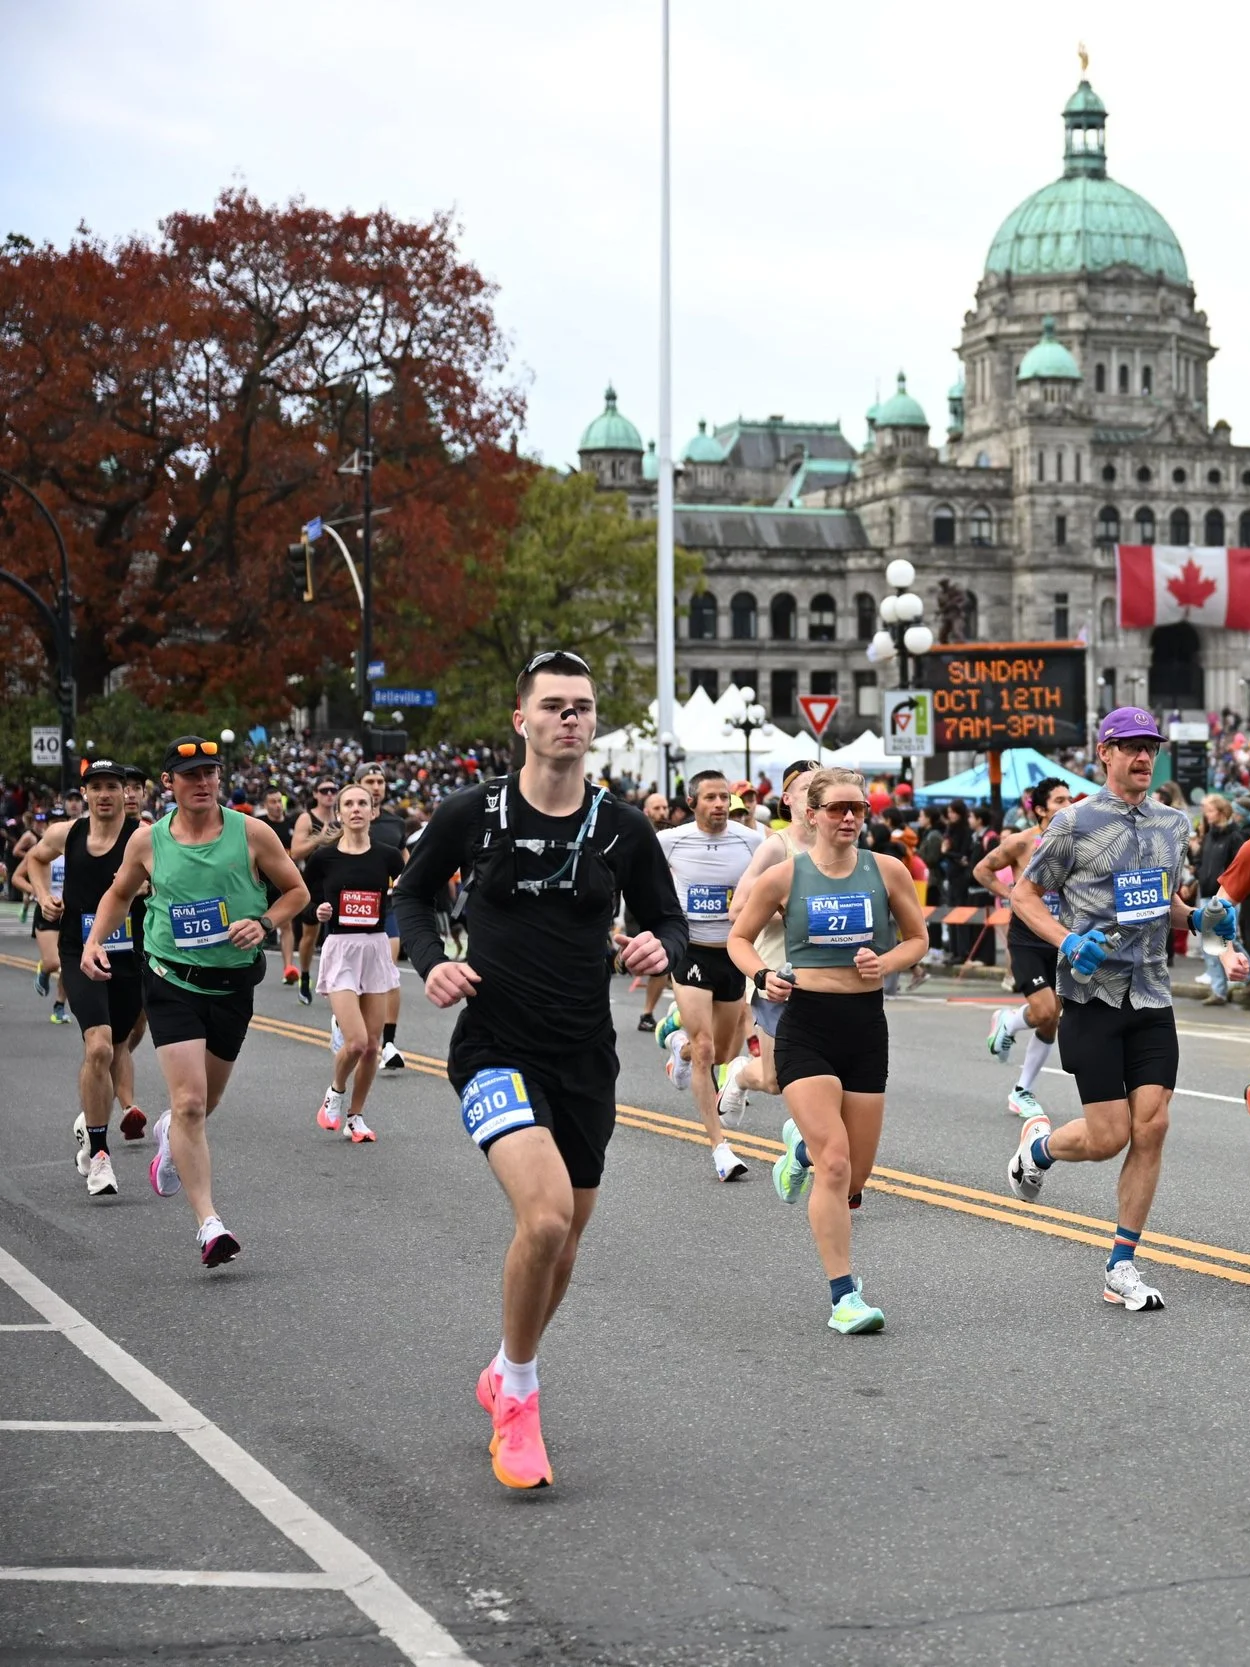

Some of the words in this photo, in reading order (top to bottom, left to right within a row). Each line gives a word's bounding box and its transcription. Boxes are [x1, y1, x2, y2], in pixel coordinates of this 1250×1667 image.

[947, 659, 1045, 685] SUNDAY
[374, 690, 421, 705] Belleville
[933, 688, 981, 713] OCT
[1000, 686, 1062, 711] 12TH
[943, 714, 1056, 741] 7AM-3PM
[34, 735, 60, 754] 40
[1117, 876, 1142, 888] RVM
[343, 893, 361, 901] RVM
[693, 899, 722, 911] 3483
[1123, 889, 1158, 907] 3359
[172, 907, 196, 918] RVM
[345, 903, 372, 915] 6243
[811, 900, 839, 912] RVM
[183, 919, 211, 935] 576
[828, 915, 848, 931] 27
[467, 1090, 508, 1129] 3910
[478, 1117, 507, 1135] WILLIAM
